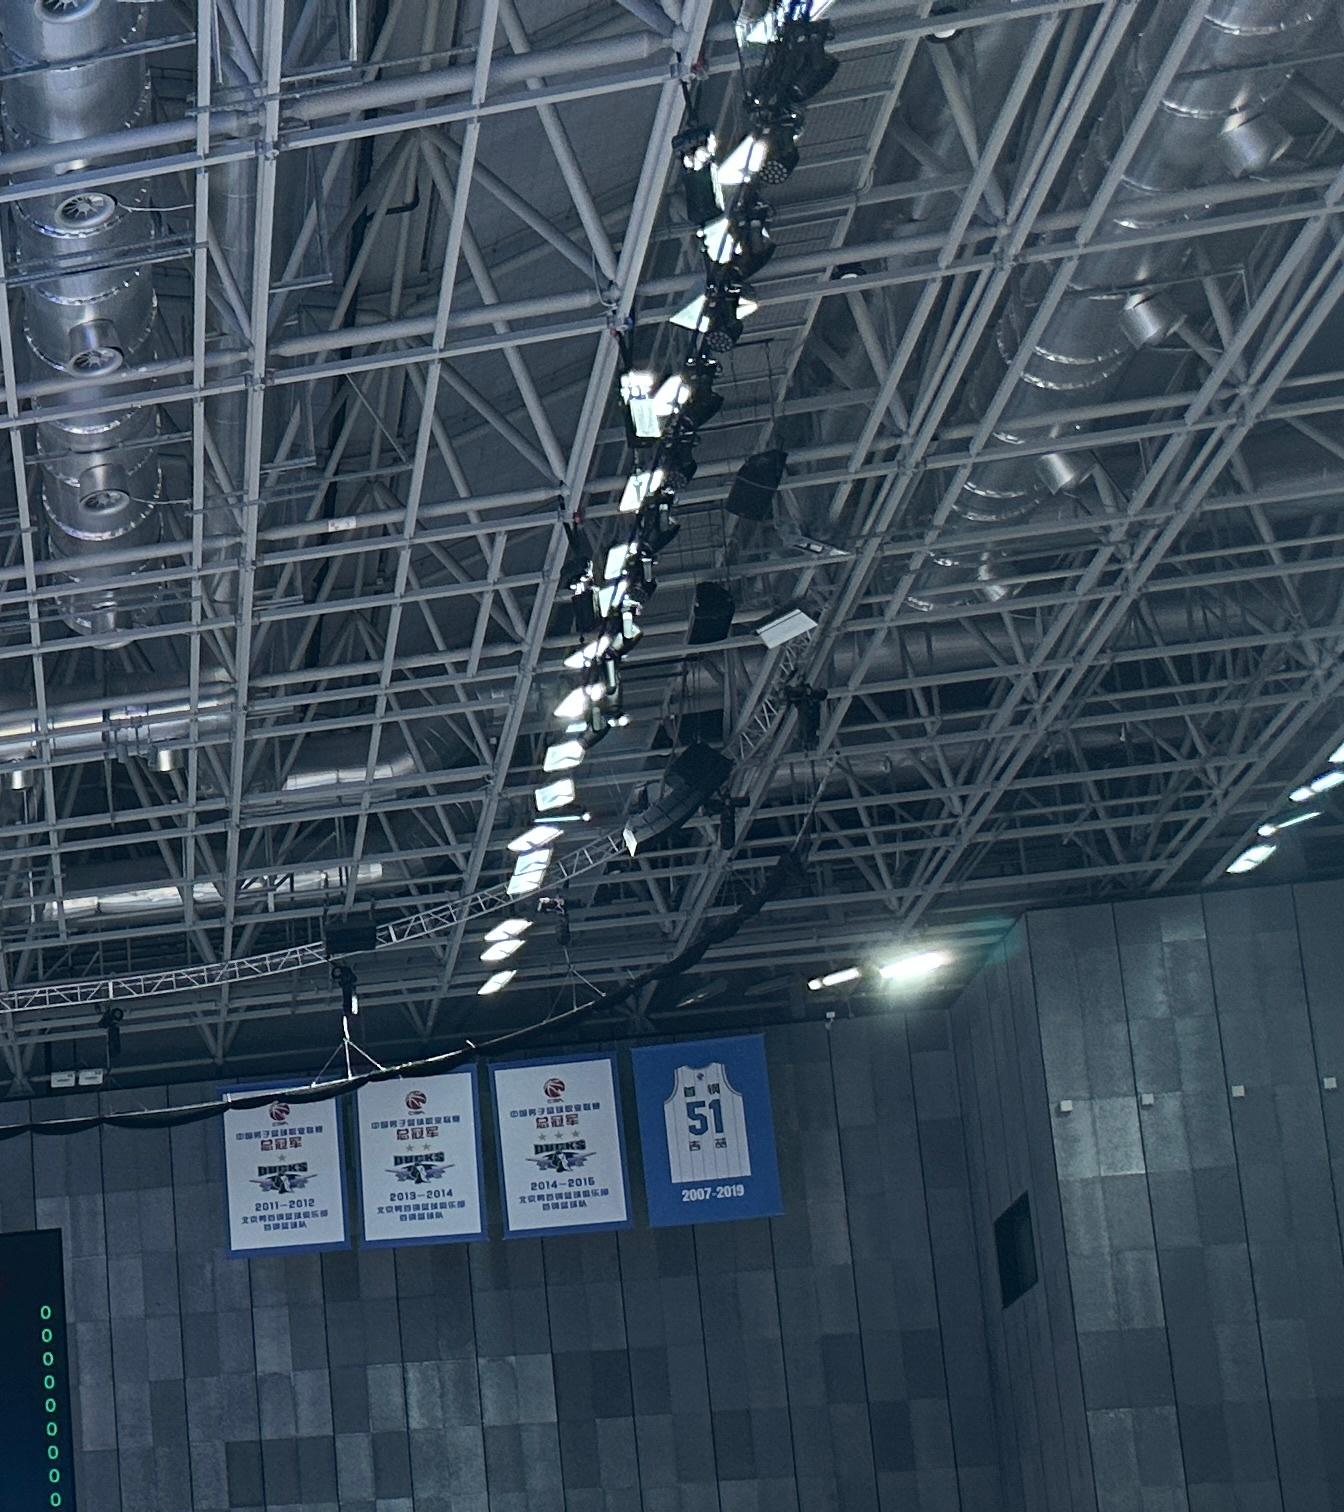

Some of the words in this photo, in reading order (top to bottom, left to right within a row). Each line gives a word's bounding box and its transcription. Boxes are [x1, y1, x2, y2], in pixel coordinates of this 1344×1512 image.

[686, 1098, 724, 1136] 51
[533, 1139, 586, 1155] DUCKS
[393, 1151, 445, 1167] DUCKS
[257, 1162, 308, 1177] DUCKS
[681, 1184, 745, 1202] 2007-2019
[40, 1305, 51, 1320] 0
[41, 1328, 52, 1343] 0
[42, 1351, 54, 1366] 0
[44, 1375, 55, 1389] 0
[45, 1398, 56, 1413] 0
[46, 1421, 58, 1436] 0
[47, 1445, 59, 1460] 0
[49, 1468, 60, 1483] 0
[50, 1492, 62, 1507] 0
